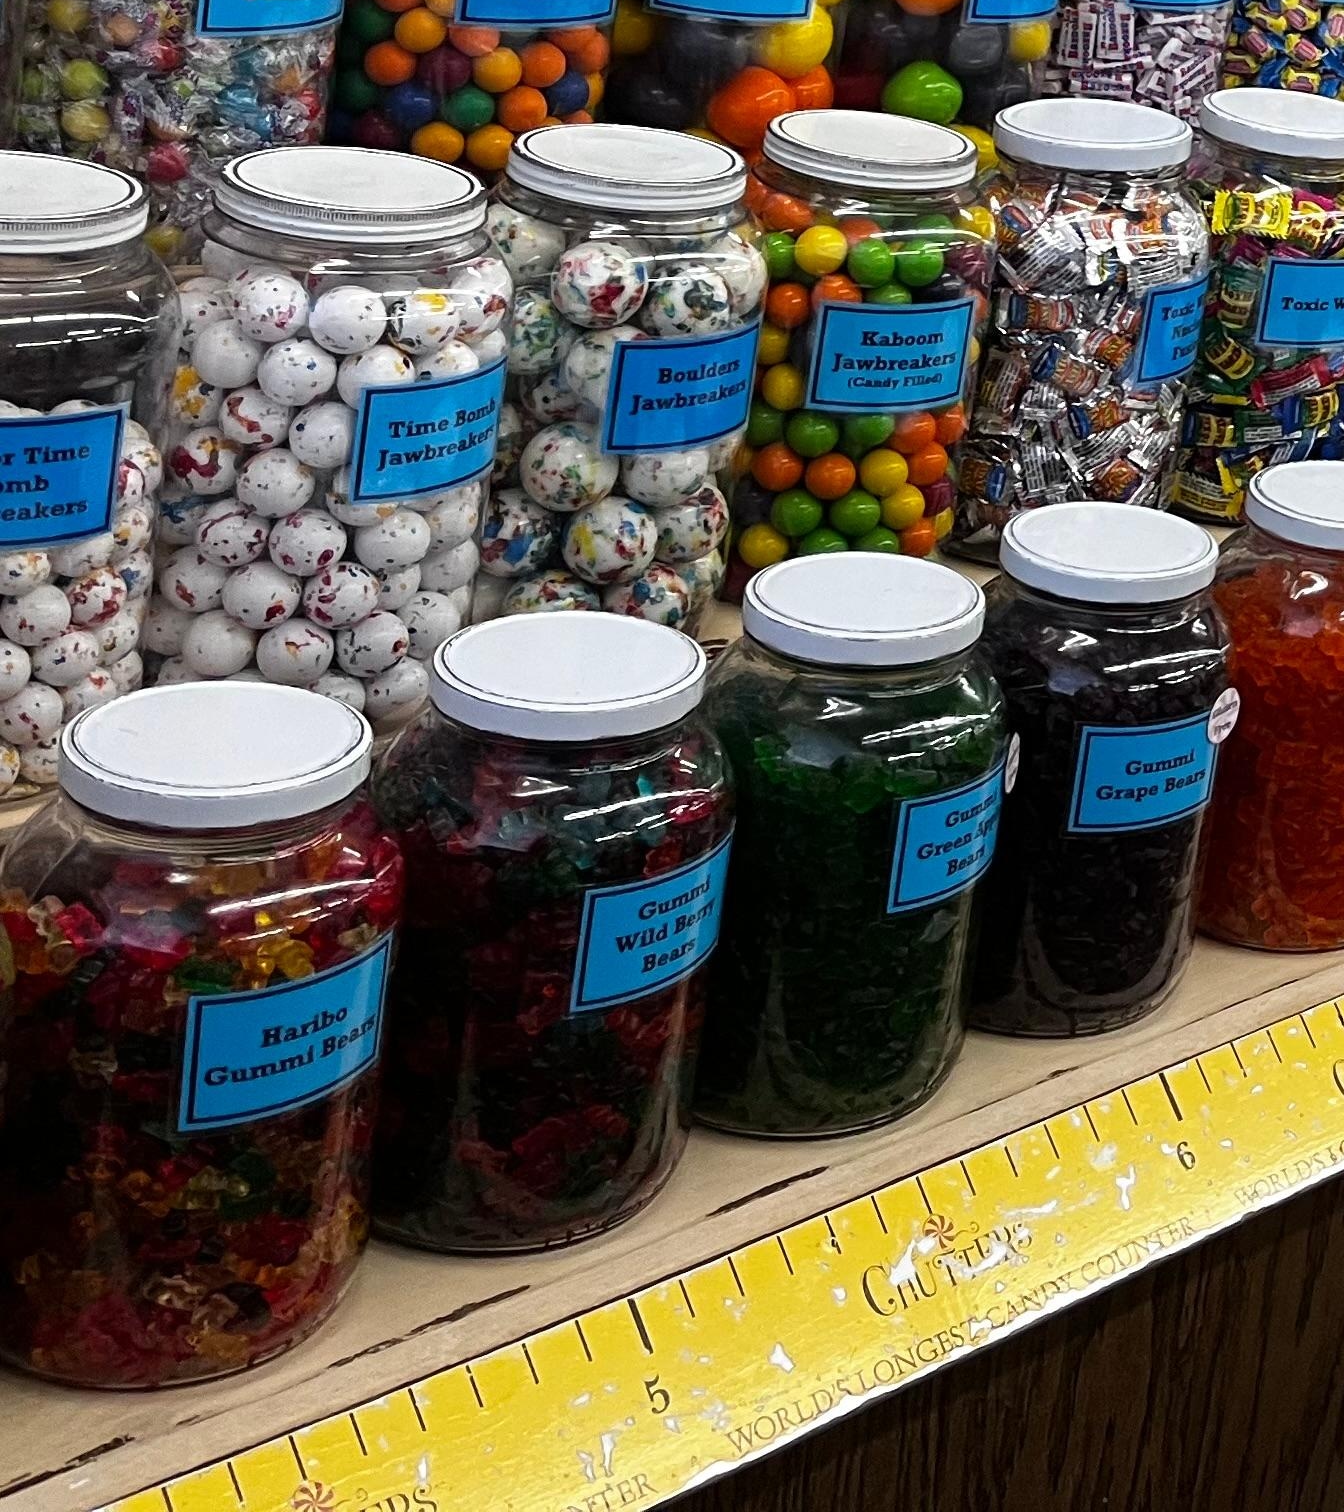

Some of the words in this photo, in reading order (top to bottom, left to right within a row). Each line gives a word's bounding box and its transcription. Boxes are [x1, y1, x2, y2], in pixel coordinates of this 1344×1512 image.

[1161, 303, 1194, 321] Toxic
[1281, 297, 1328, 311] Toxic
[860, 329, 945, 348] Kaboom
[657, 357, 740, 385] Boulders
[831, 349, 957, 374] Jawbreakers
[631, 380, 746, 415] Jawbreakers
[847, 374, 900, 391] (Candy
[903, 372, 943, 388] Filled)
[388, 419, 449, 440] Time
[454, 402, 496, 429] Bomb
[24, 445, 90, 464] Time
[1125, 749, 1196, 776] Gummi
[1095, 782, 1159, 805] Grape
[1164, 769, 1206, 796] Bears
[917, 832, 973, 860] Green
[637, 875, 711, 921] Gummi
[615, 922, 669, 954] Wild
[672, 899, 716, 941] Berry
[642, 937, 696, 973] Bears
[261, 1003, 348, 1049] Haribo
[203, 1043, 314, 1088] Gummi
[320, 1015, 377, 1063] Bears
[1175, 1141, 1196, 1172] 6
[1234, 1149, 1324, 1206] WORLD'S
[727, 1378, 852, 1450] WORLD'S
[853, 1324, 971, 1394] LONGEST
[986, 1270, 1074, 1328] CANDY
[1081, 1216, 1196, 1285] COUNTER
[643, 1374, 671, 1414] 5
